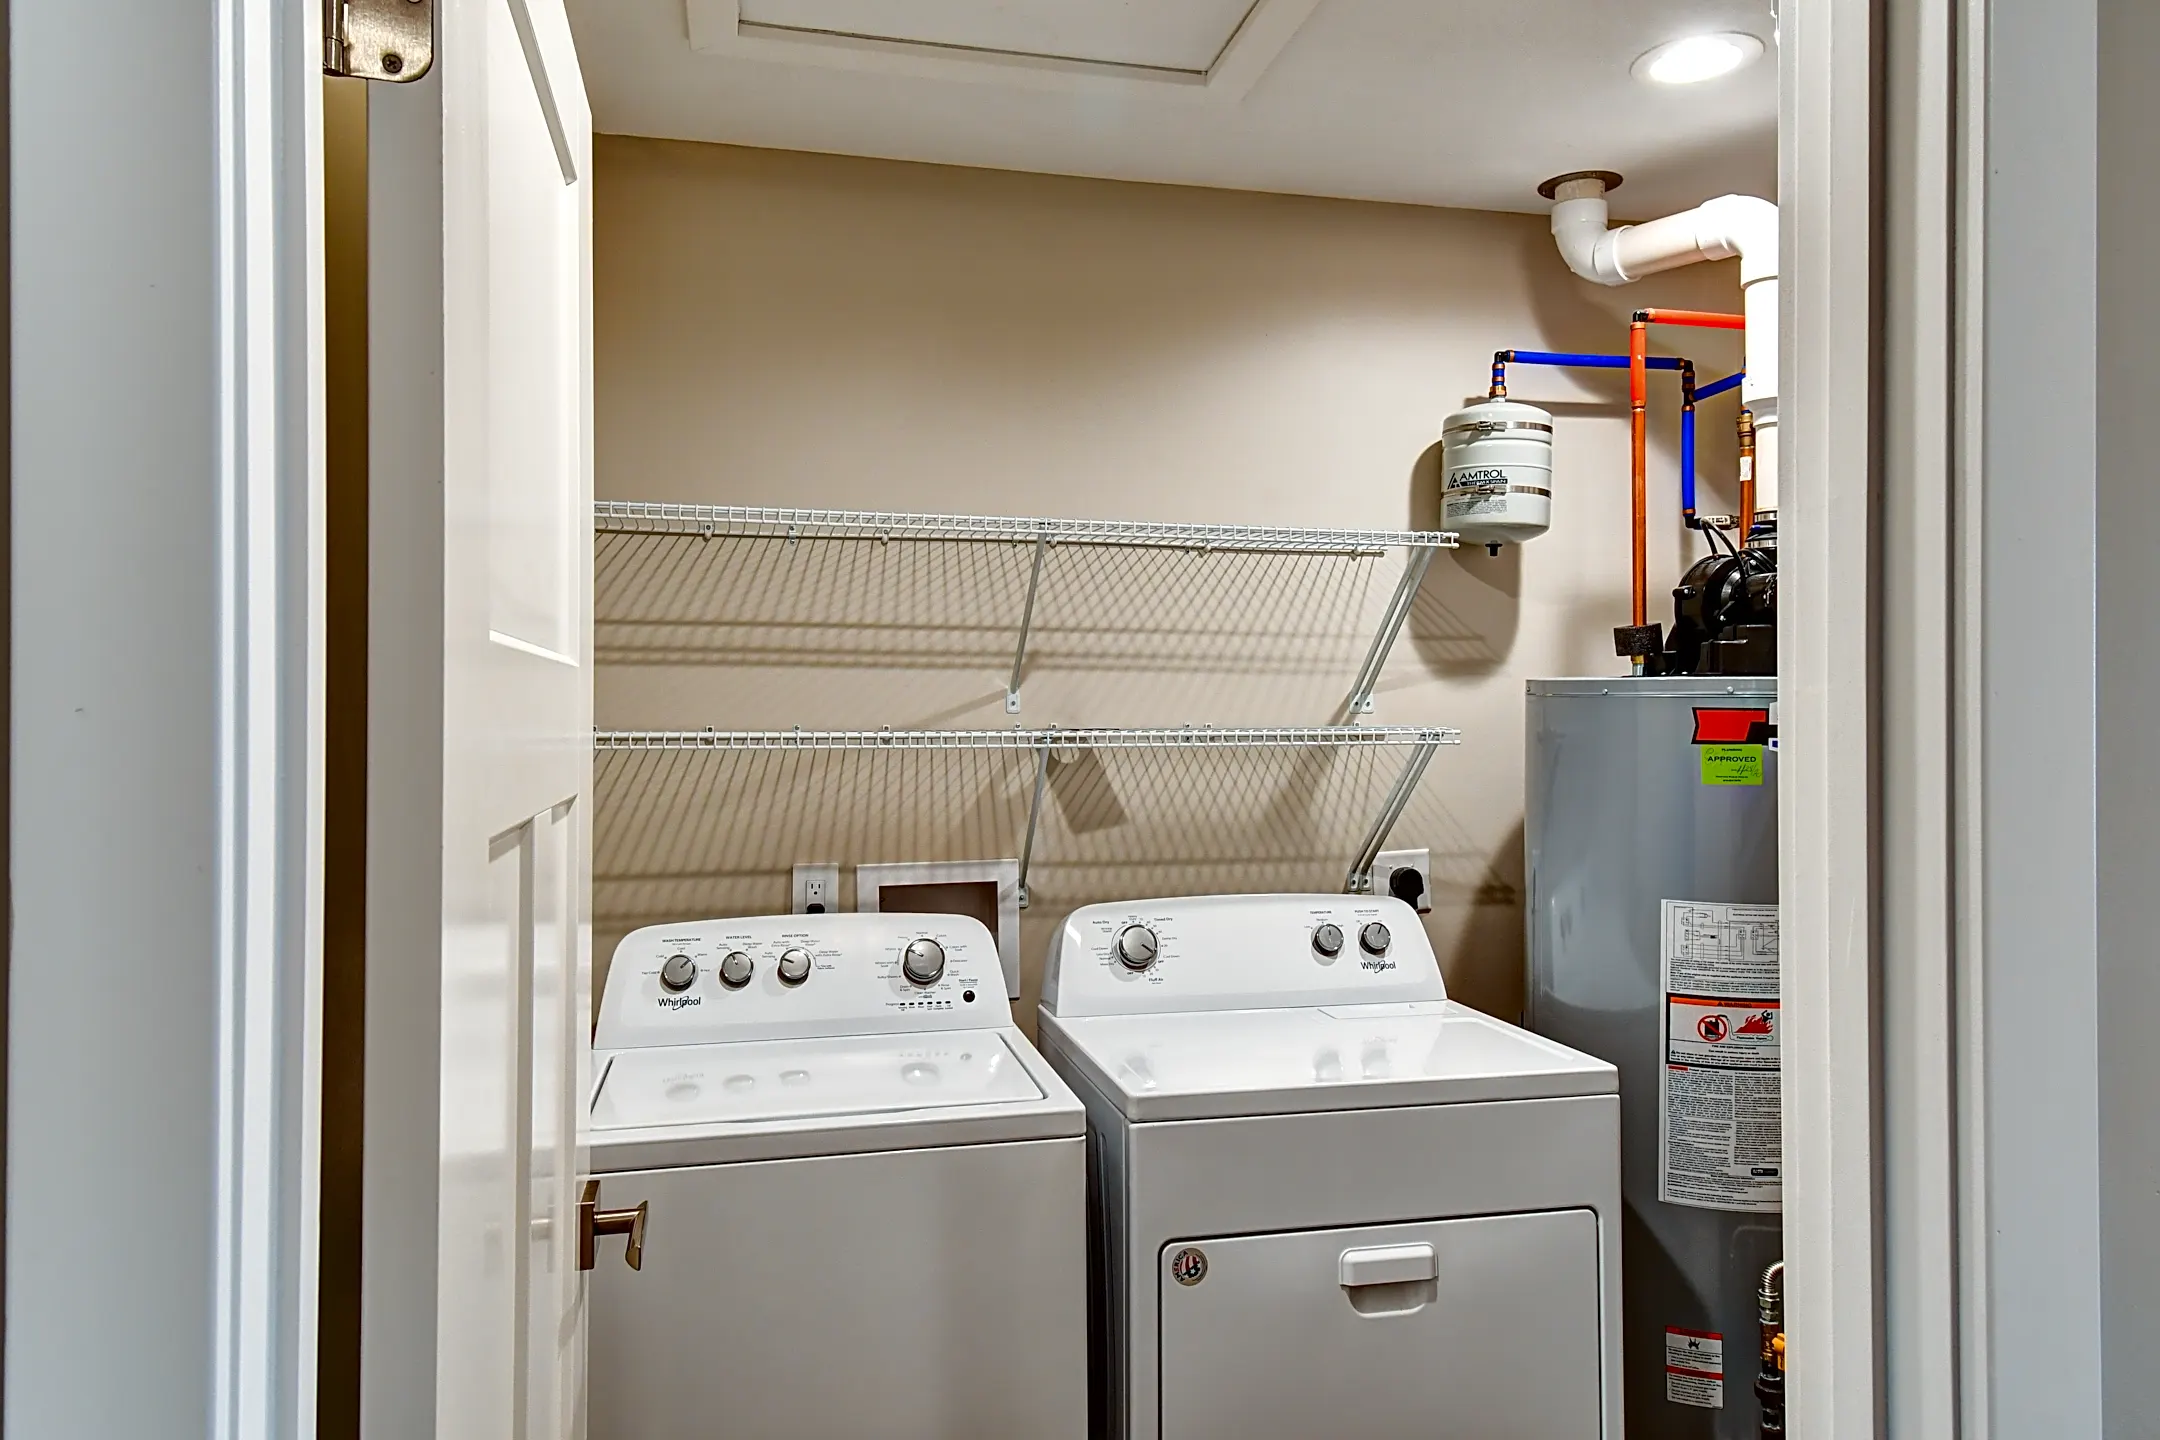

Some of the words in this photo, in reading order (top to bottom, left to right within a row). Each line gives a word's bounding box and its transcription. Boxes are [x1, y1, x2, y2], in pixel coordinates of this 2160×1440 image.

[1460, 469, 1505, 481] AMTROL
[1360, 960, 1397, 973] Whirlpool
[658, 996, 701, 1010] Whirlpool
